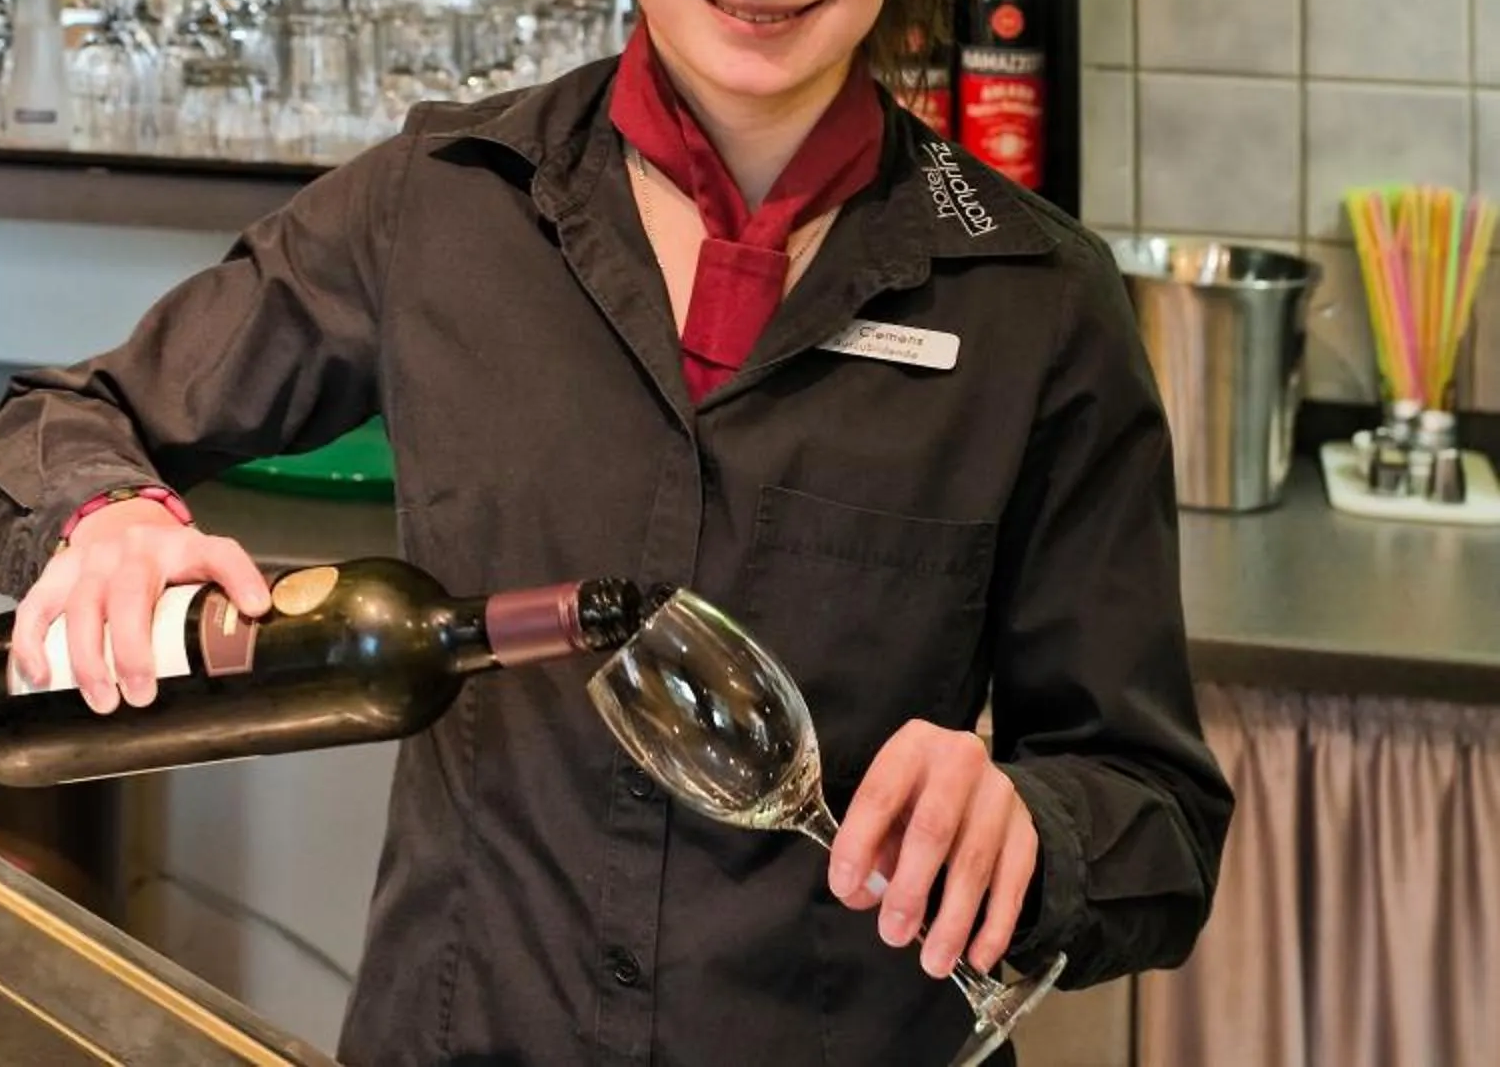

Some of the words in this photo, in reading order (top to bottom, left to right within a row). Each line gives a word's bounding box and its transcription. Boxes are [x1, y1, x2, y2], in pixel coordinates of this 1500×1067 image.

[921, 164, 957, 221] hotel
[930, 141, 998, 235] kronprinz
[858, 324, 924, 347] Cemens
